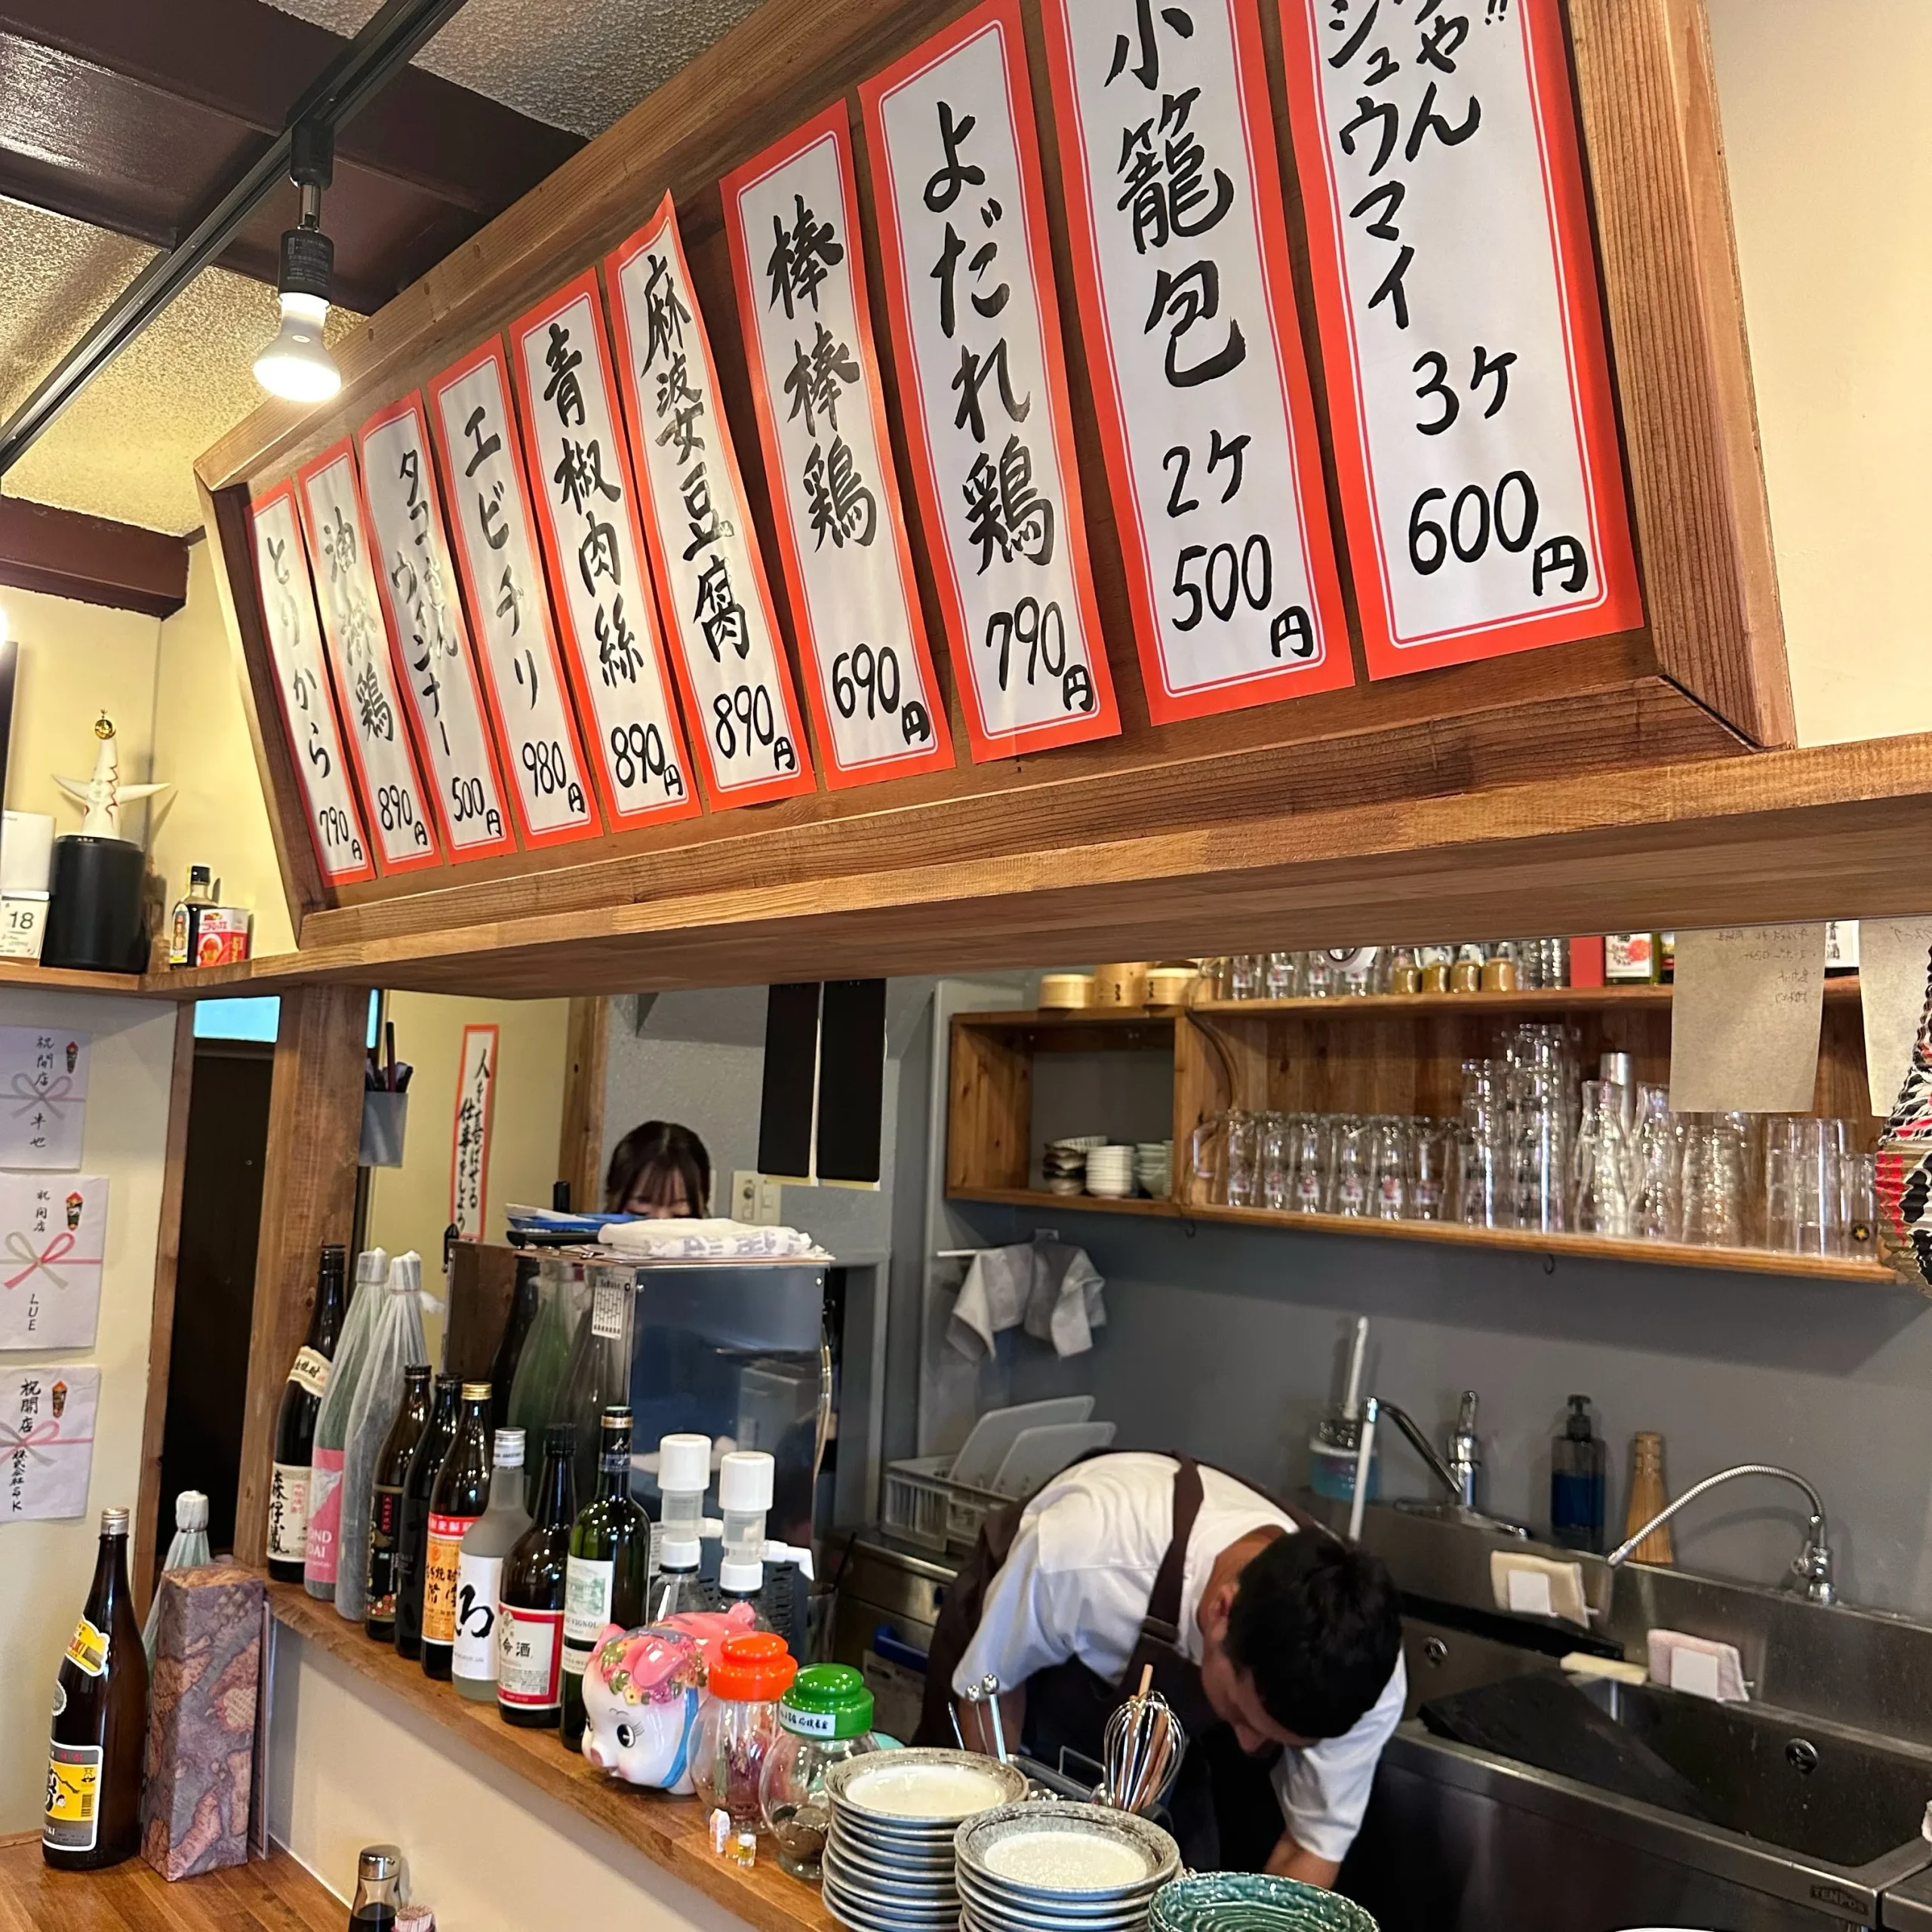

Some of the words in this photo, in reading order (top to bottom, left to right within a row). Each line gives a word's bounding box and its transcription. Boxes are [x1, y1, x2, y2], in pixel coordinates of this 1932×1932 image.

[1104, 0, 1247, 388] 小籠包
[766, 193, 878, 552] 棒棒鶏
[922, 100, 1056, 576] よだれ鶏
[544, 321, 645, 688] 青椒肉絲
[641, 254, 749, 663] 麻婆豆腐
[463, 406, 539, 711] エビチリ
[1408, 470, 1589, 597] 600円
[1171, 534, 1315, 658] 500円
[266, 536, 331, 779] とりから
[831, 642, 931, 746] 690円
[983, 595, 1094, 713] 790円
[521, 739, 586, 814] 980円
[614, 721, 685, 797] 890円
[713, 685, 795, 771] 890円
[319, 805, 363, 861] 790円
[377, 784, 429, 846] 890円
[452, 776, 503, 836] 500円
[10, 911, 34, 930] 18
[18, 1379, 41, 1433] 祝開店
[499, 1635, 531, 1658] 命酒
